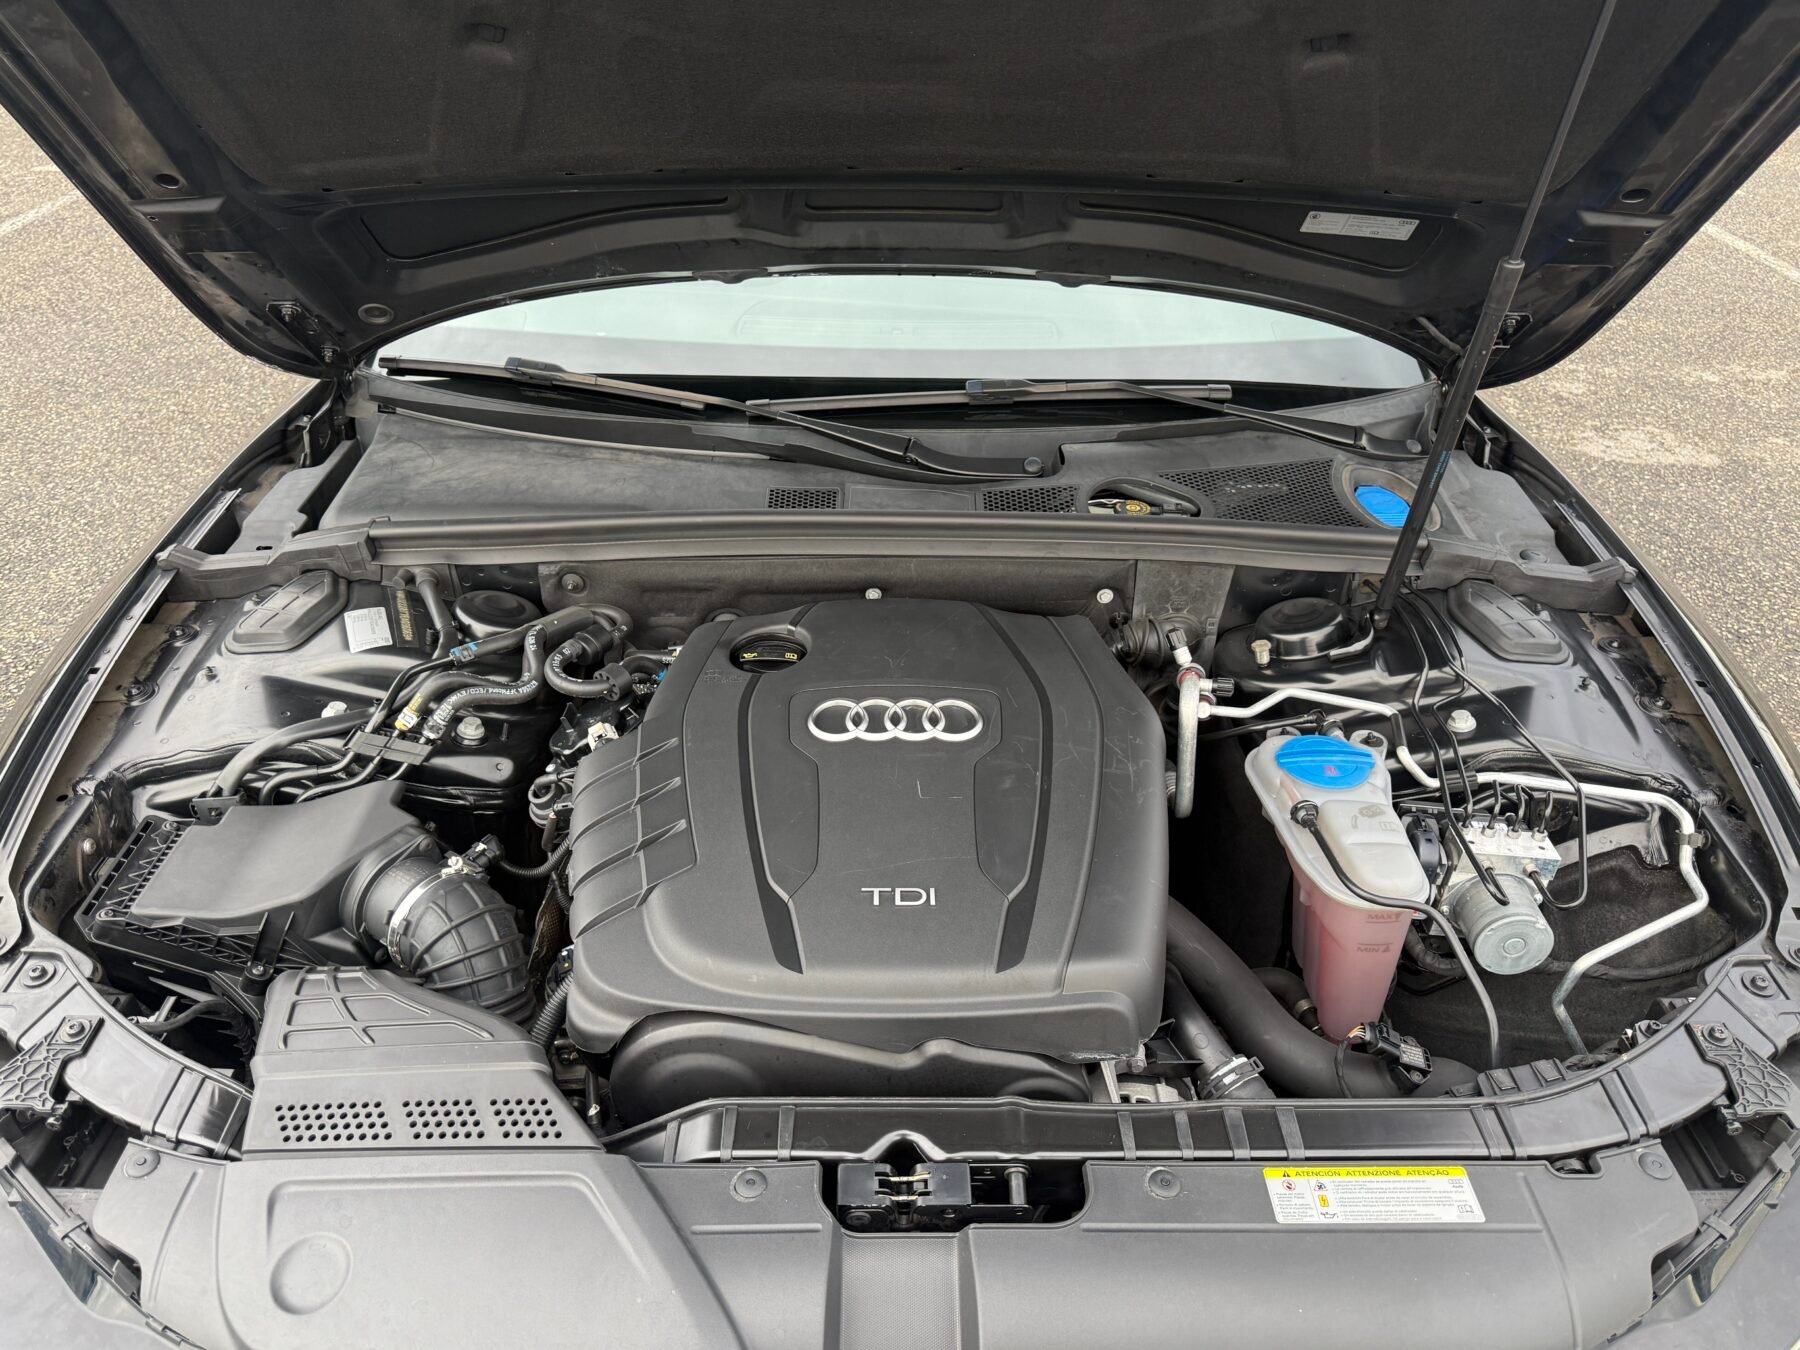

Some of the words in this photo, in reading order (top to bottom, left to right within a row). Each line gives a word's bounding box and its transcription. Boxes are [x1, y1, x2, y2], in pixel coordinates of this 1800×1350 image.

[861, 887, 936, 906] TDI
[1295, 1169, 1341, 1177] ATENCIÓN
[1346, 1169, 1401, 1177] ATTENZIONE
